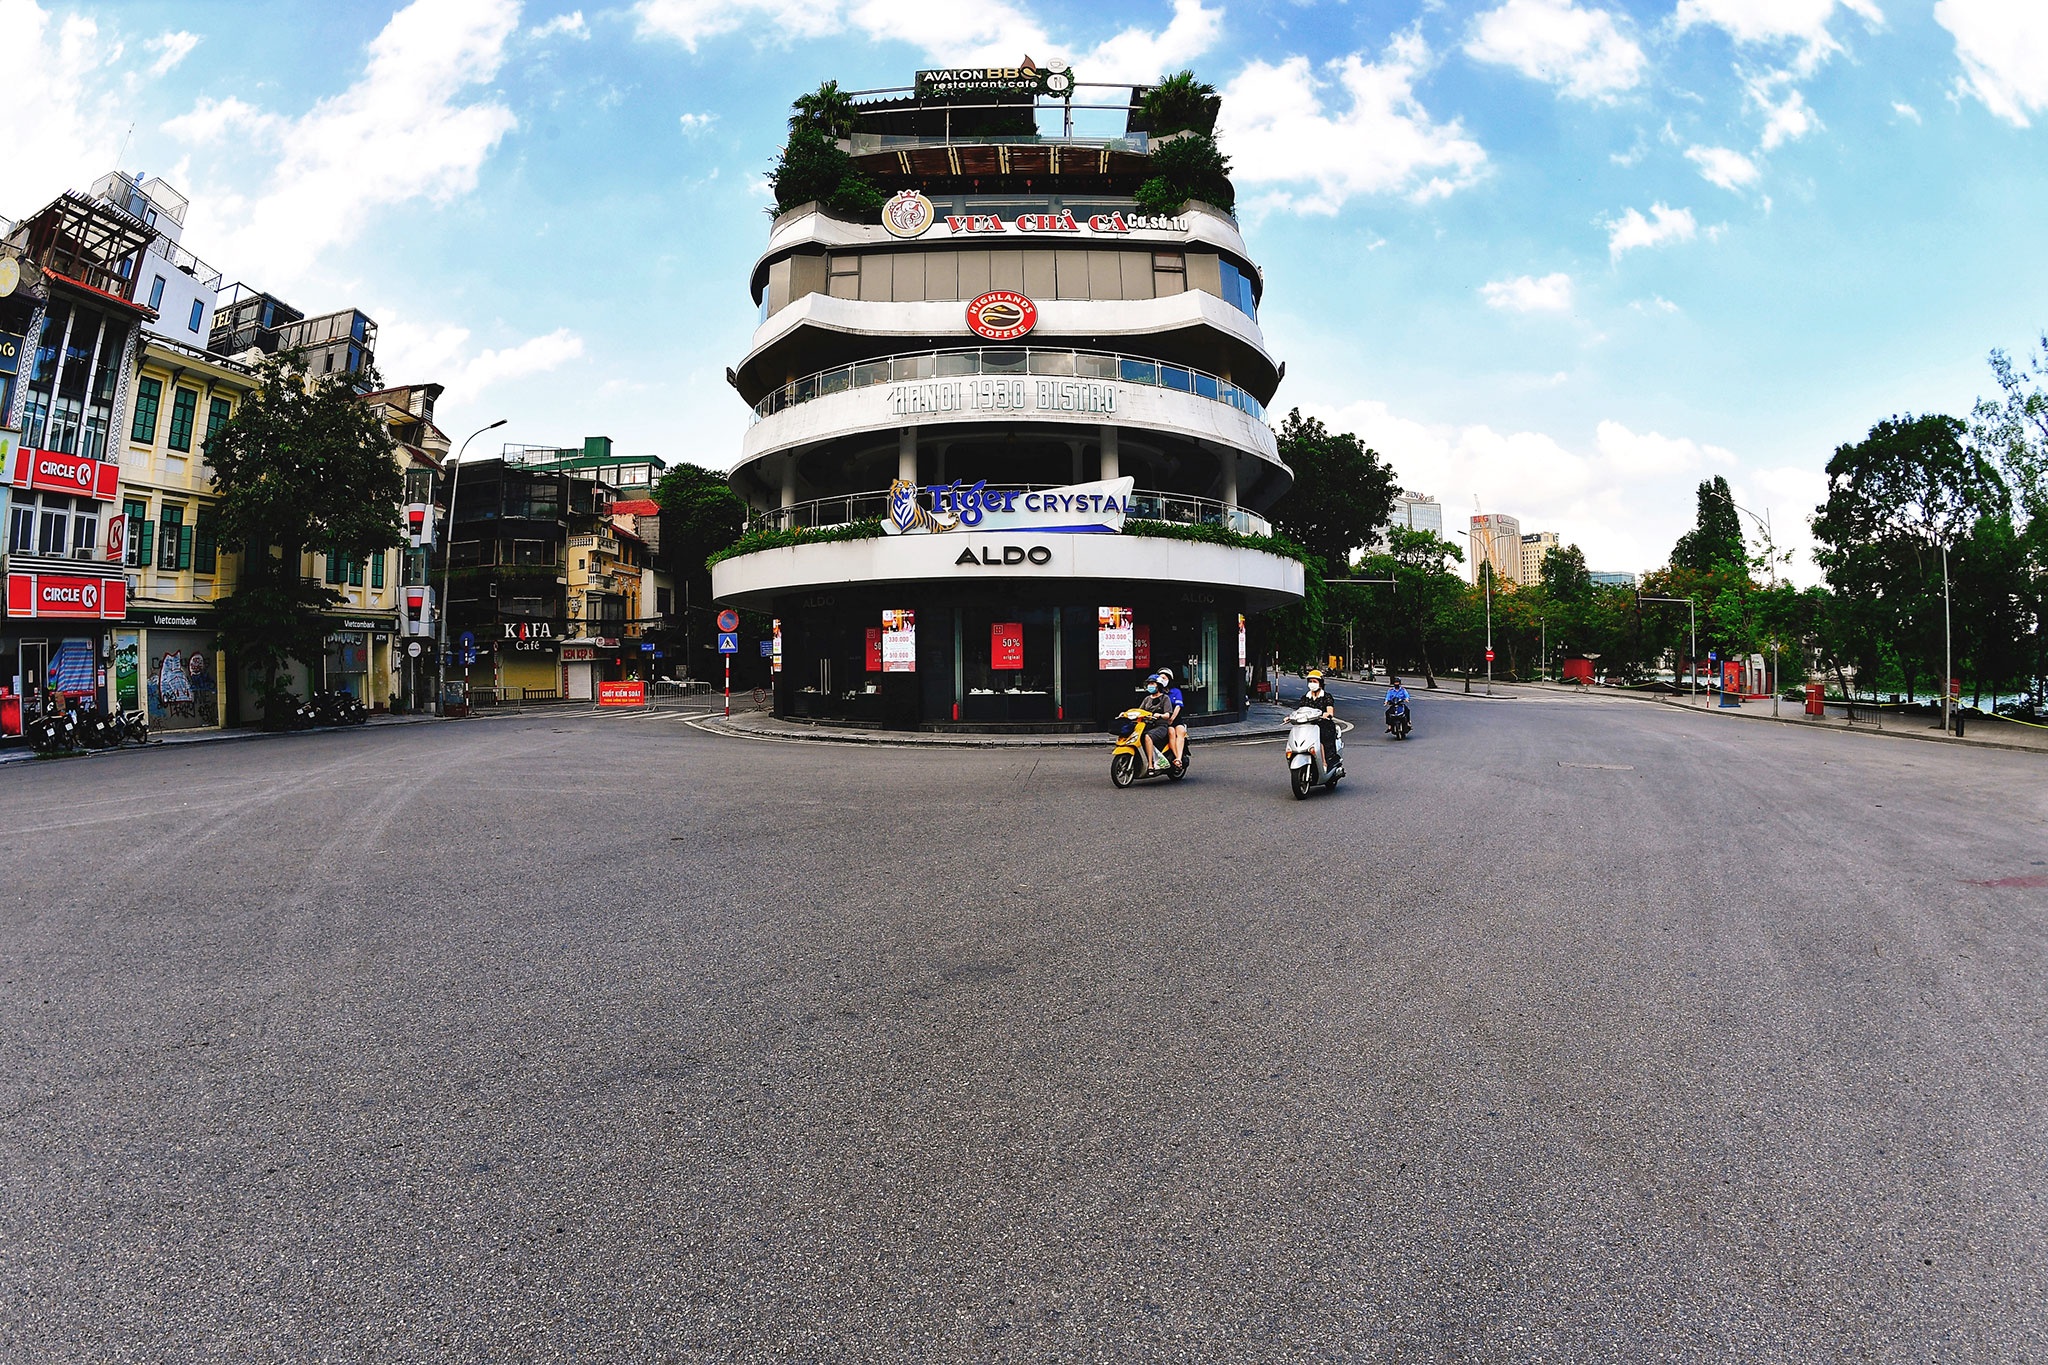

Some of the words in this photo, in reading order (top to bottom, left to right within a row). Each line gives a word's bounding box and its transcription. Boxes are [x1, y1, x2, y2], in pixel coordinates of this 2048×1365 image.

[924, 70, 984, 83] AVALON
[933, 80, 1002, 90] restaurant
[1008, 80, 1038, 89] cafe
[944, 214, 1006, 234] VUA
[1015, 208, 1081, 233] CHẢ
[1088, 210, 1129, 233] CÁ
[969, 293, 1034, 315] HIGHLANDS
[977, 325, 1027, 338] COFFEE
[892, 382, 962, 415] HANOI
[969, 379, 1025, 410] 1930
[1035, 380, 1118, 413] BISTRO
[39, 461, 76, 480] CIRCLE
[80, 465, 92, 485] K
[926, 479, 1021, 527] Tiger
[1025, 493, 1136, 513] CRYSTAL
[954, 545, 1053, 566] ALDO
[42, 587, 80, 602] CIRCLE
[84, 586, 97, 608] K
[802, 596, 836, 609] ALDO
[1181, 593, 1215, 604] ALDO
[153, 615, 197, 626] Vietcombank
[343, 619, 376, 629] Vietcombank
[504, 622, 552, 640] KAFA
[515, 640, 541, 652] Café
